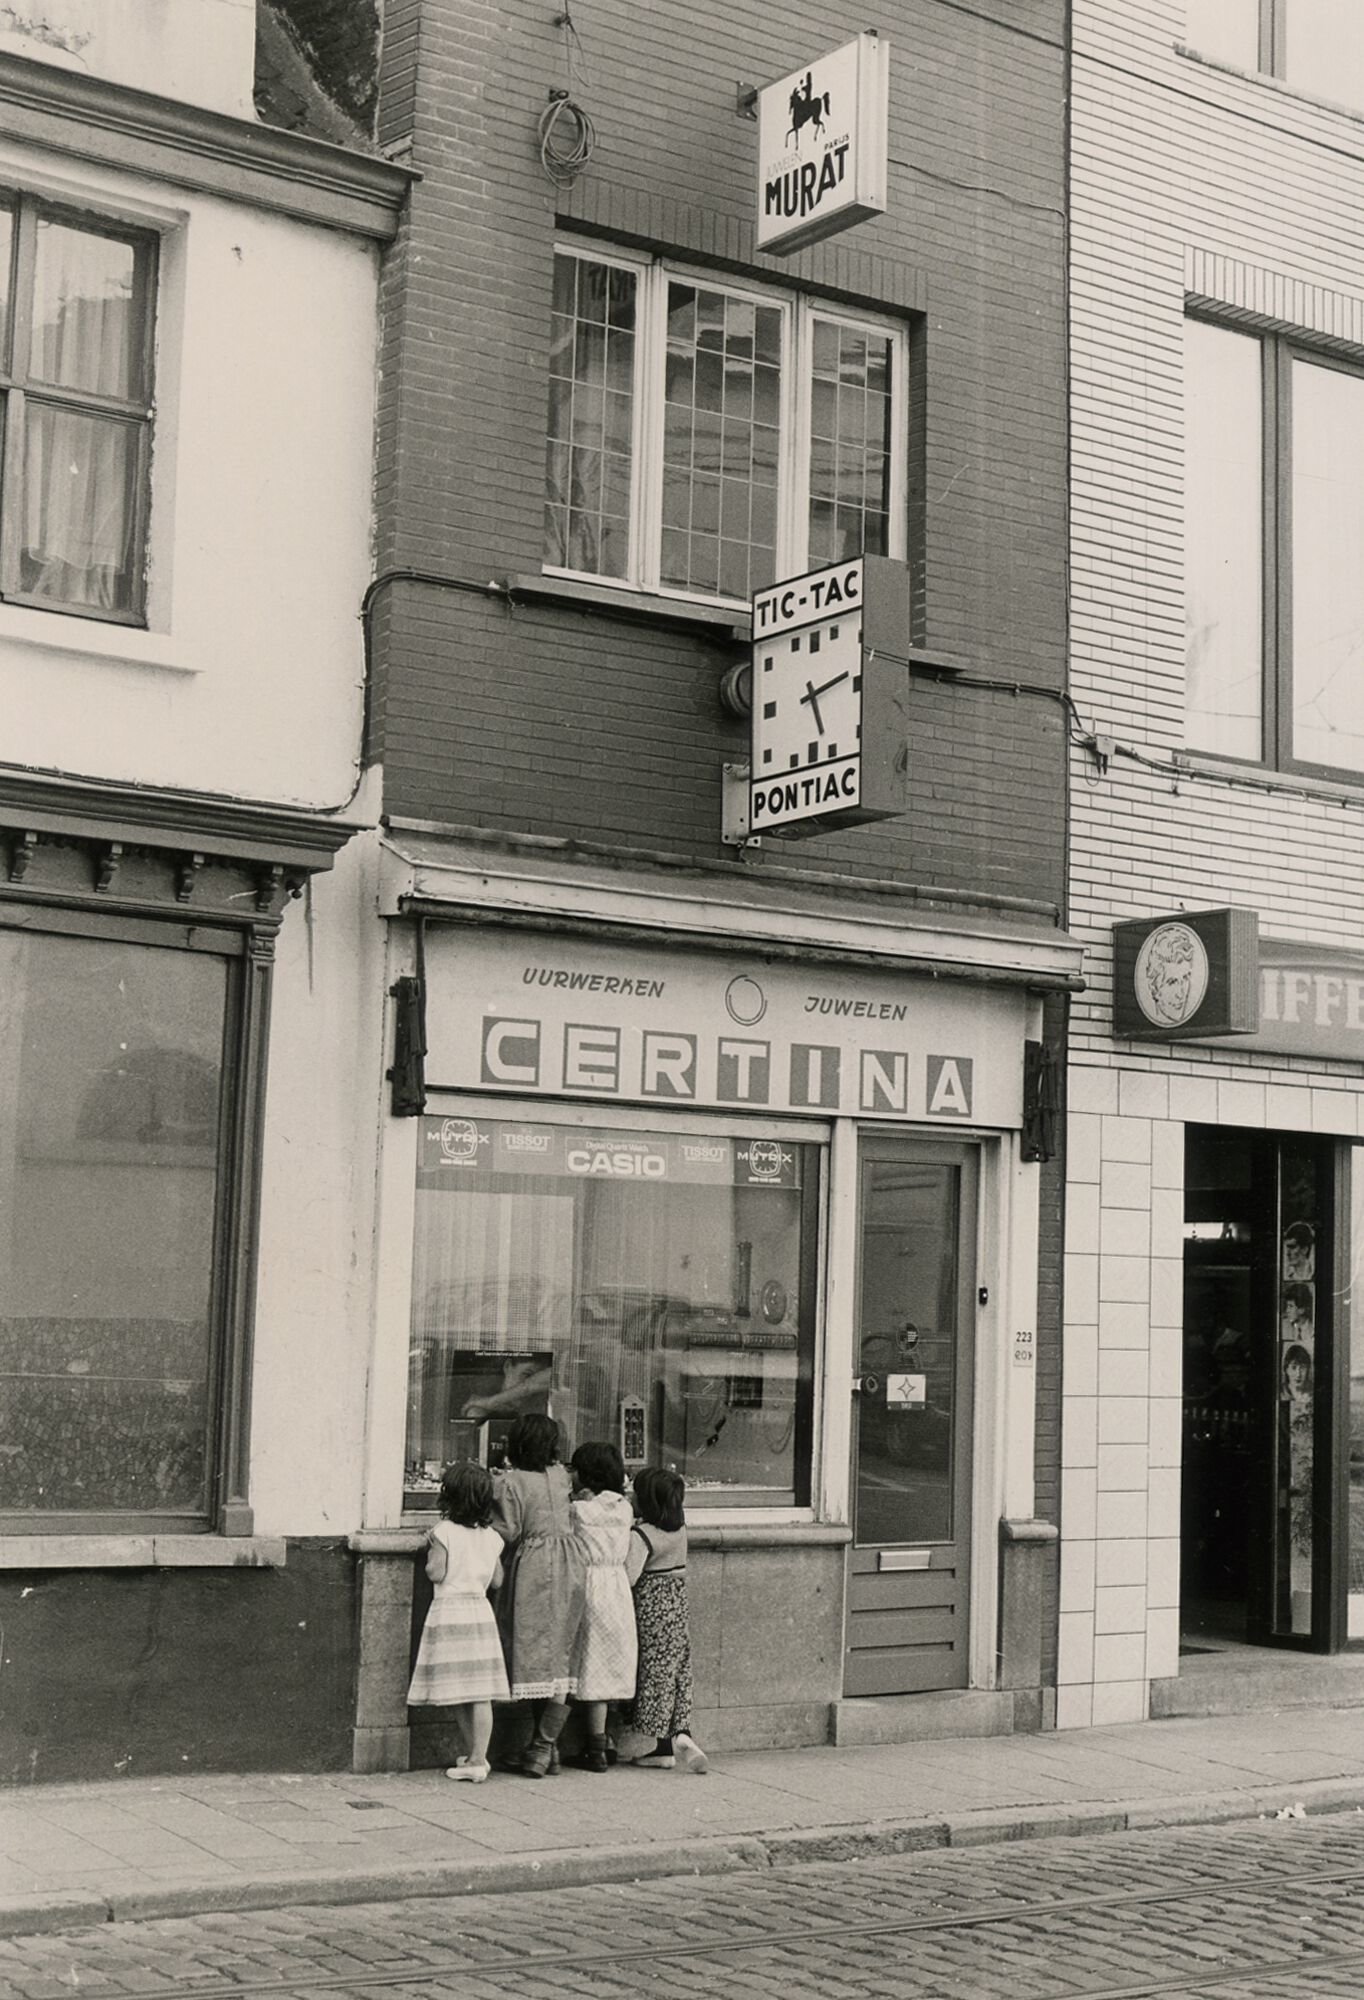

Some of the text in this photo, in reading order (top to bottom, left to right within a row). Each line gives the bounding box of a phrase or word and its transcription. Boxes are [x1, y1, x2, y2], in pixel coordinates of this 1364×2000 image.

[765, 143, 849, 217] MURAT
[757, 570, 858, 627] TIC-TAC
[754, 767, 856, 819] PONTIAC
[522, 967, 908, 1021] UURWERKEN JUWELEN
[483, 1018, 971, 1115] CERTINA
[502, 1133, 551, 1148] TISSOT
[567, 1150, 666, 1177] CASIO
[681, 1145, 727, 1160] TISSOT
[1016, 1331, 1033, 1343] 223
